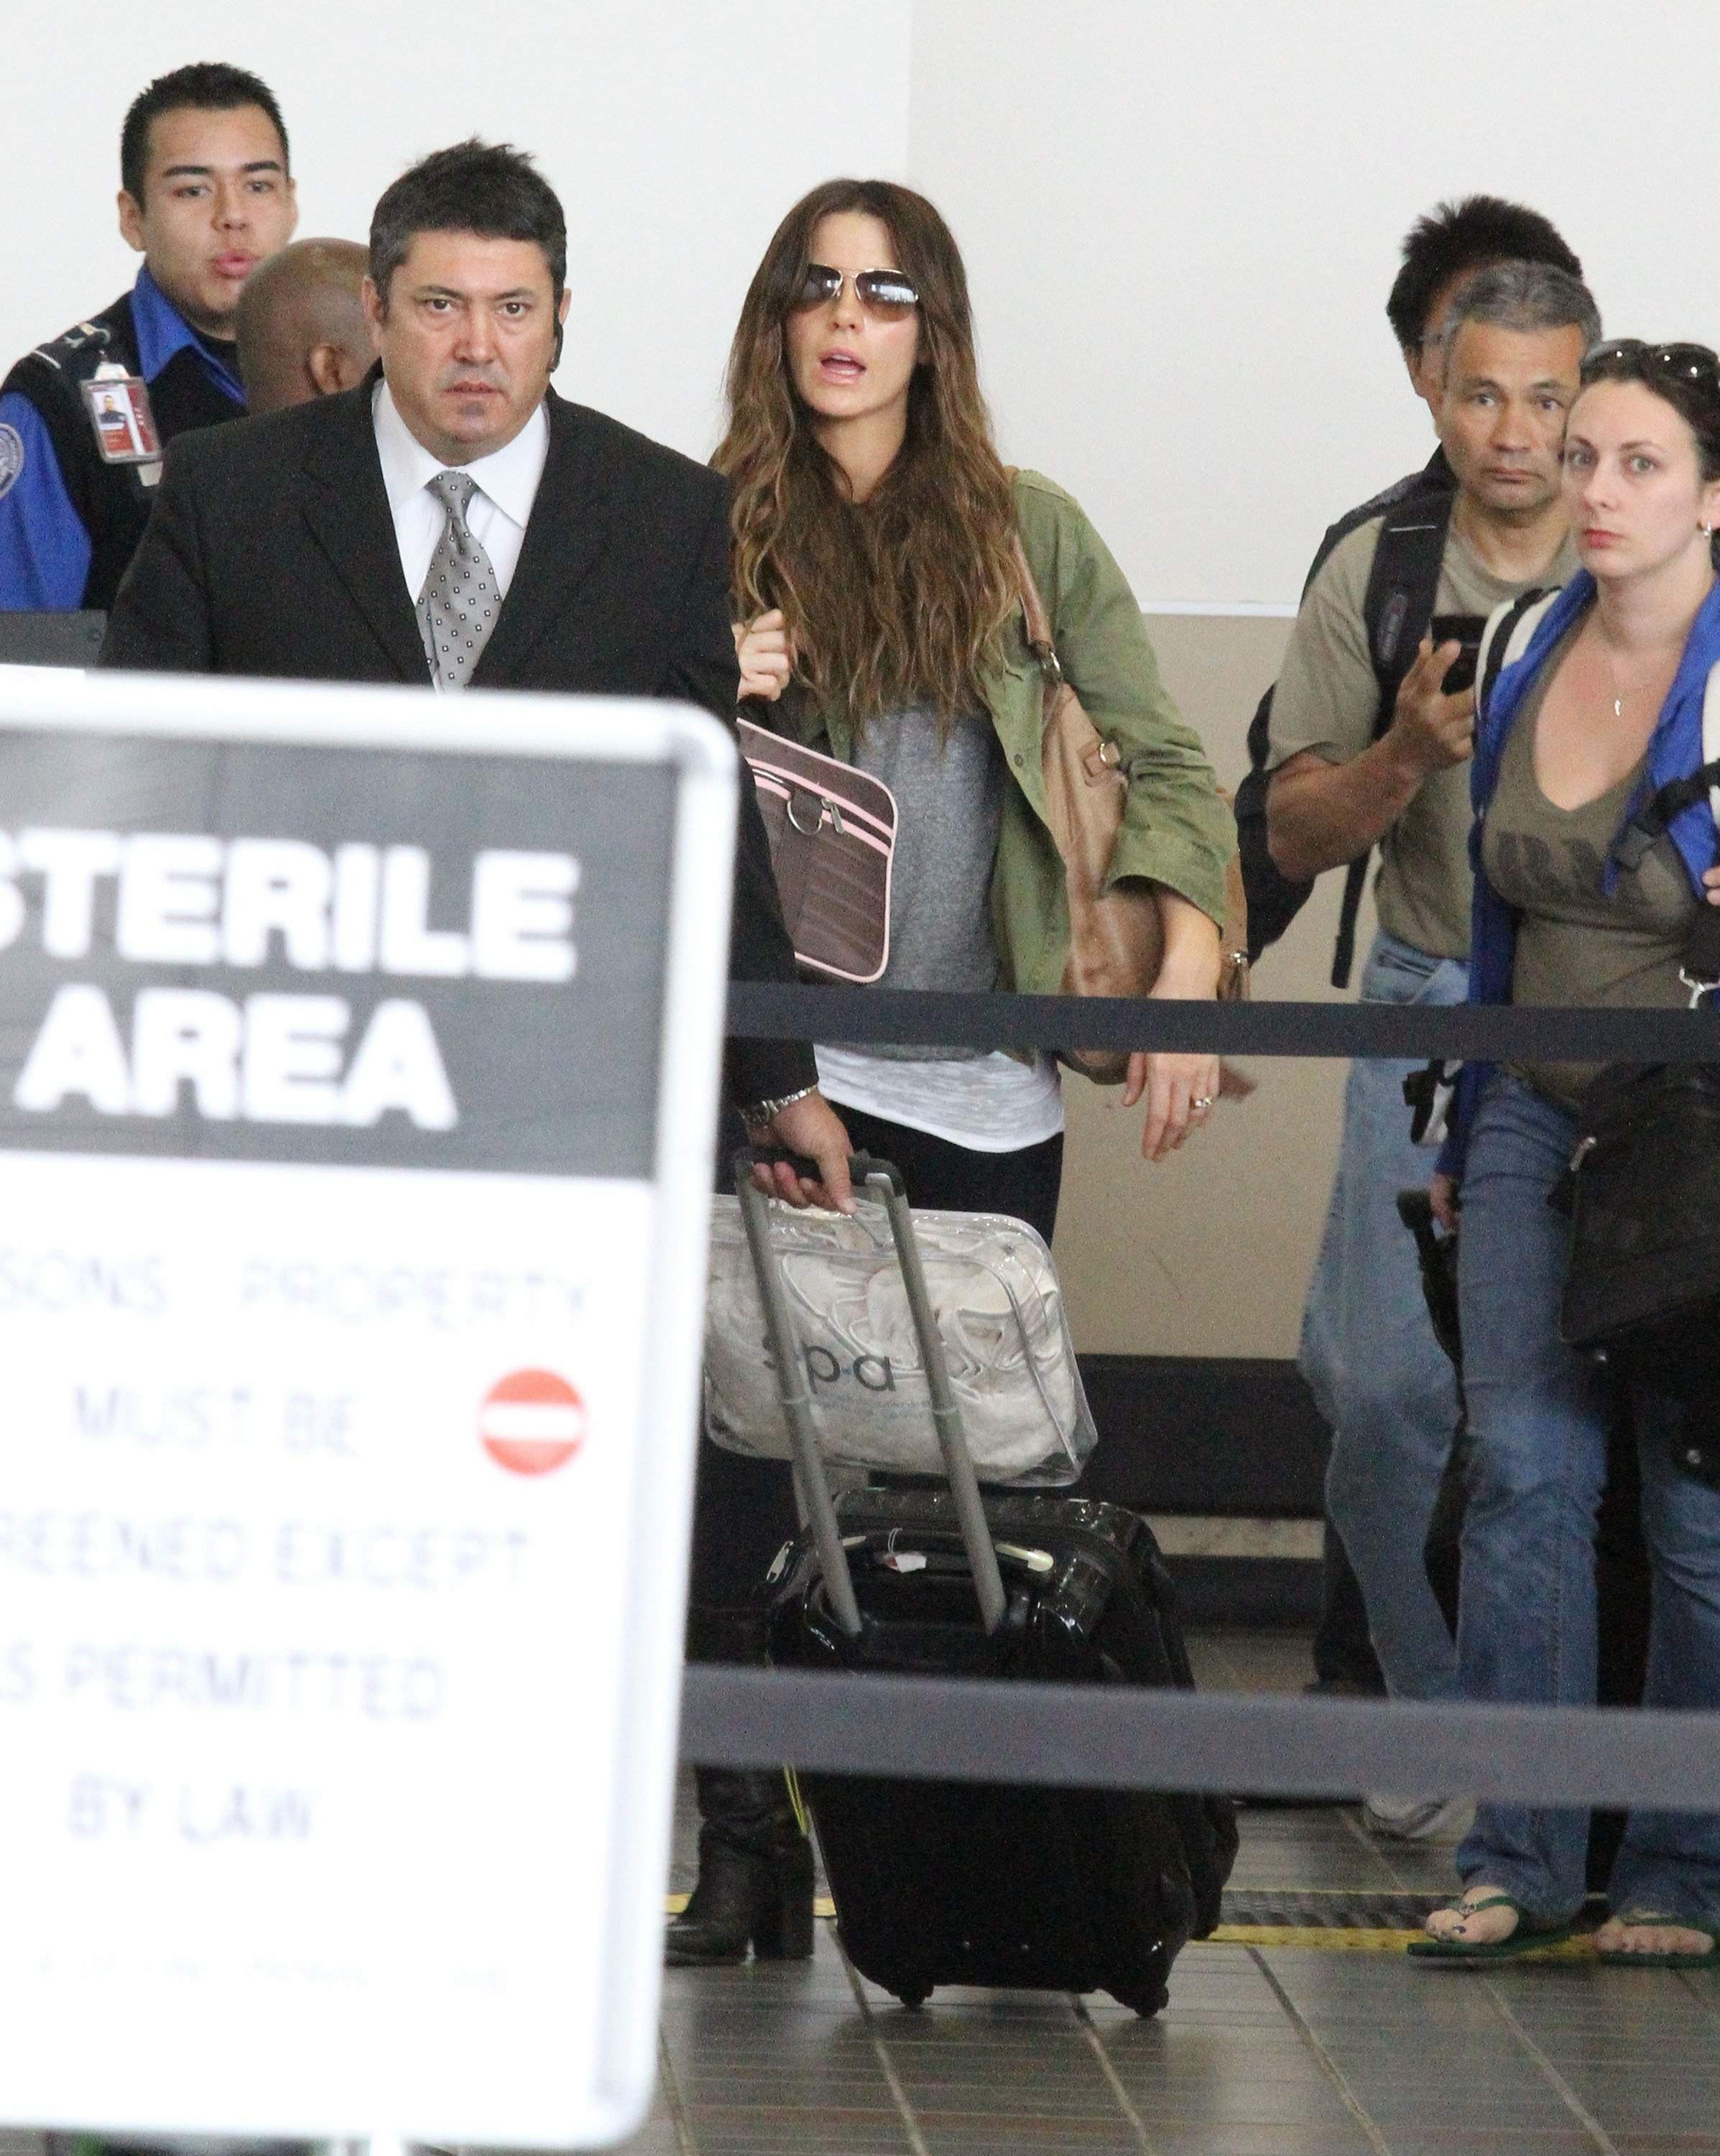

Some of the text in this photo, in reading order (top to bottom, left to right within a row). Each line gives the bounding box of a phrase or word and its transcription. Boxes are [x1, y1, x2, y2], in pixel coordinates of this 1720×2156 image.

[0, 828, 578, 982] TERILE
[13, 983, 458, 1132] AREA
[241, 1260, 588, 1330] PROPERTY
[72, 1384, 356, 1455] MUST BE
[274, 1519, 529, 1590] EXCEPT
[64, 1642, 442, 1721] PERMITTED
[66, 1769, 314, 1845] BY LAW
